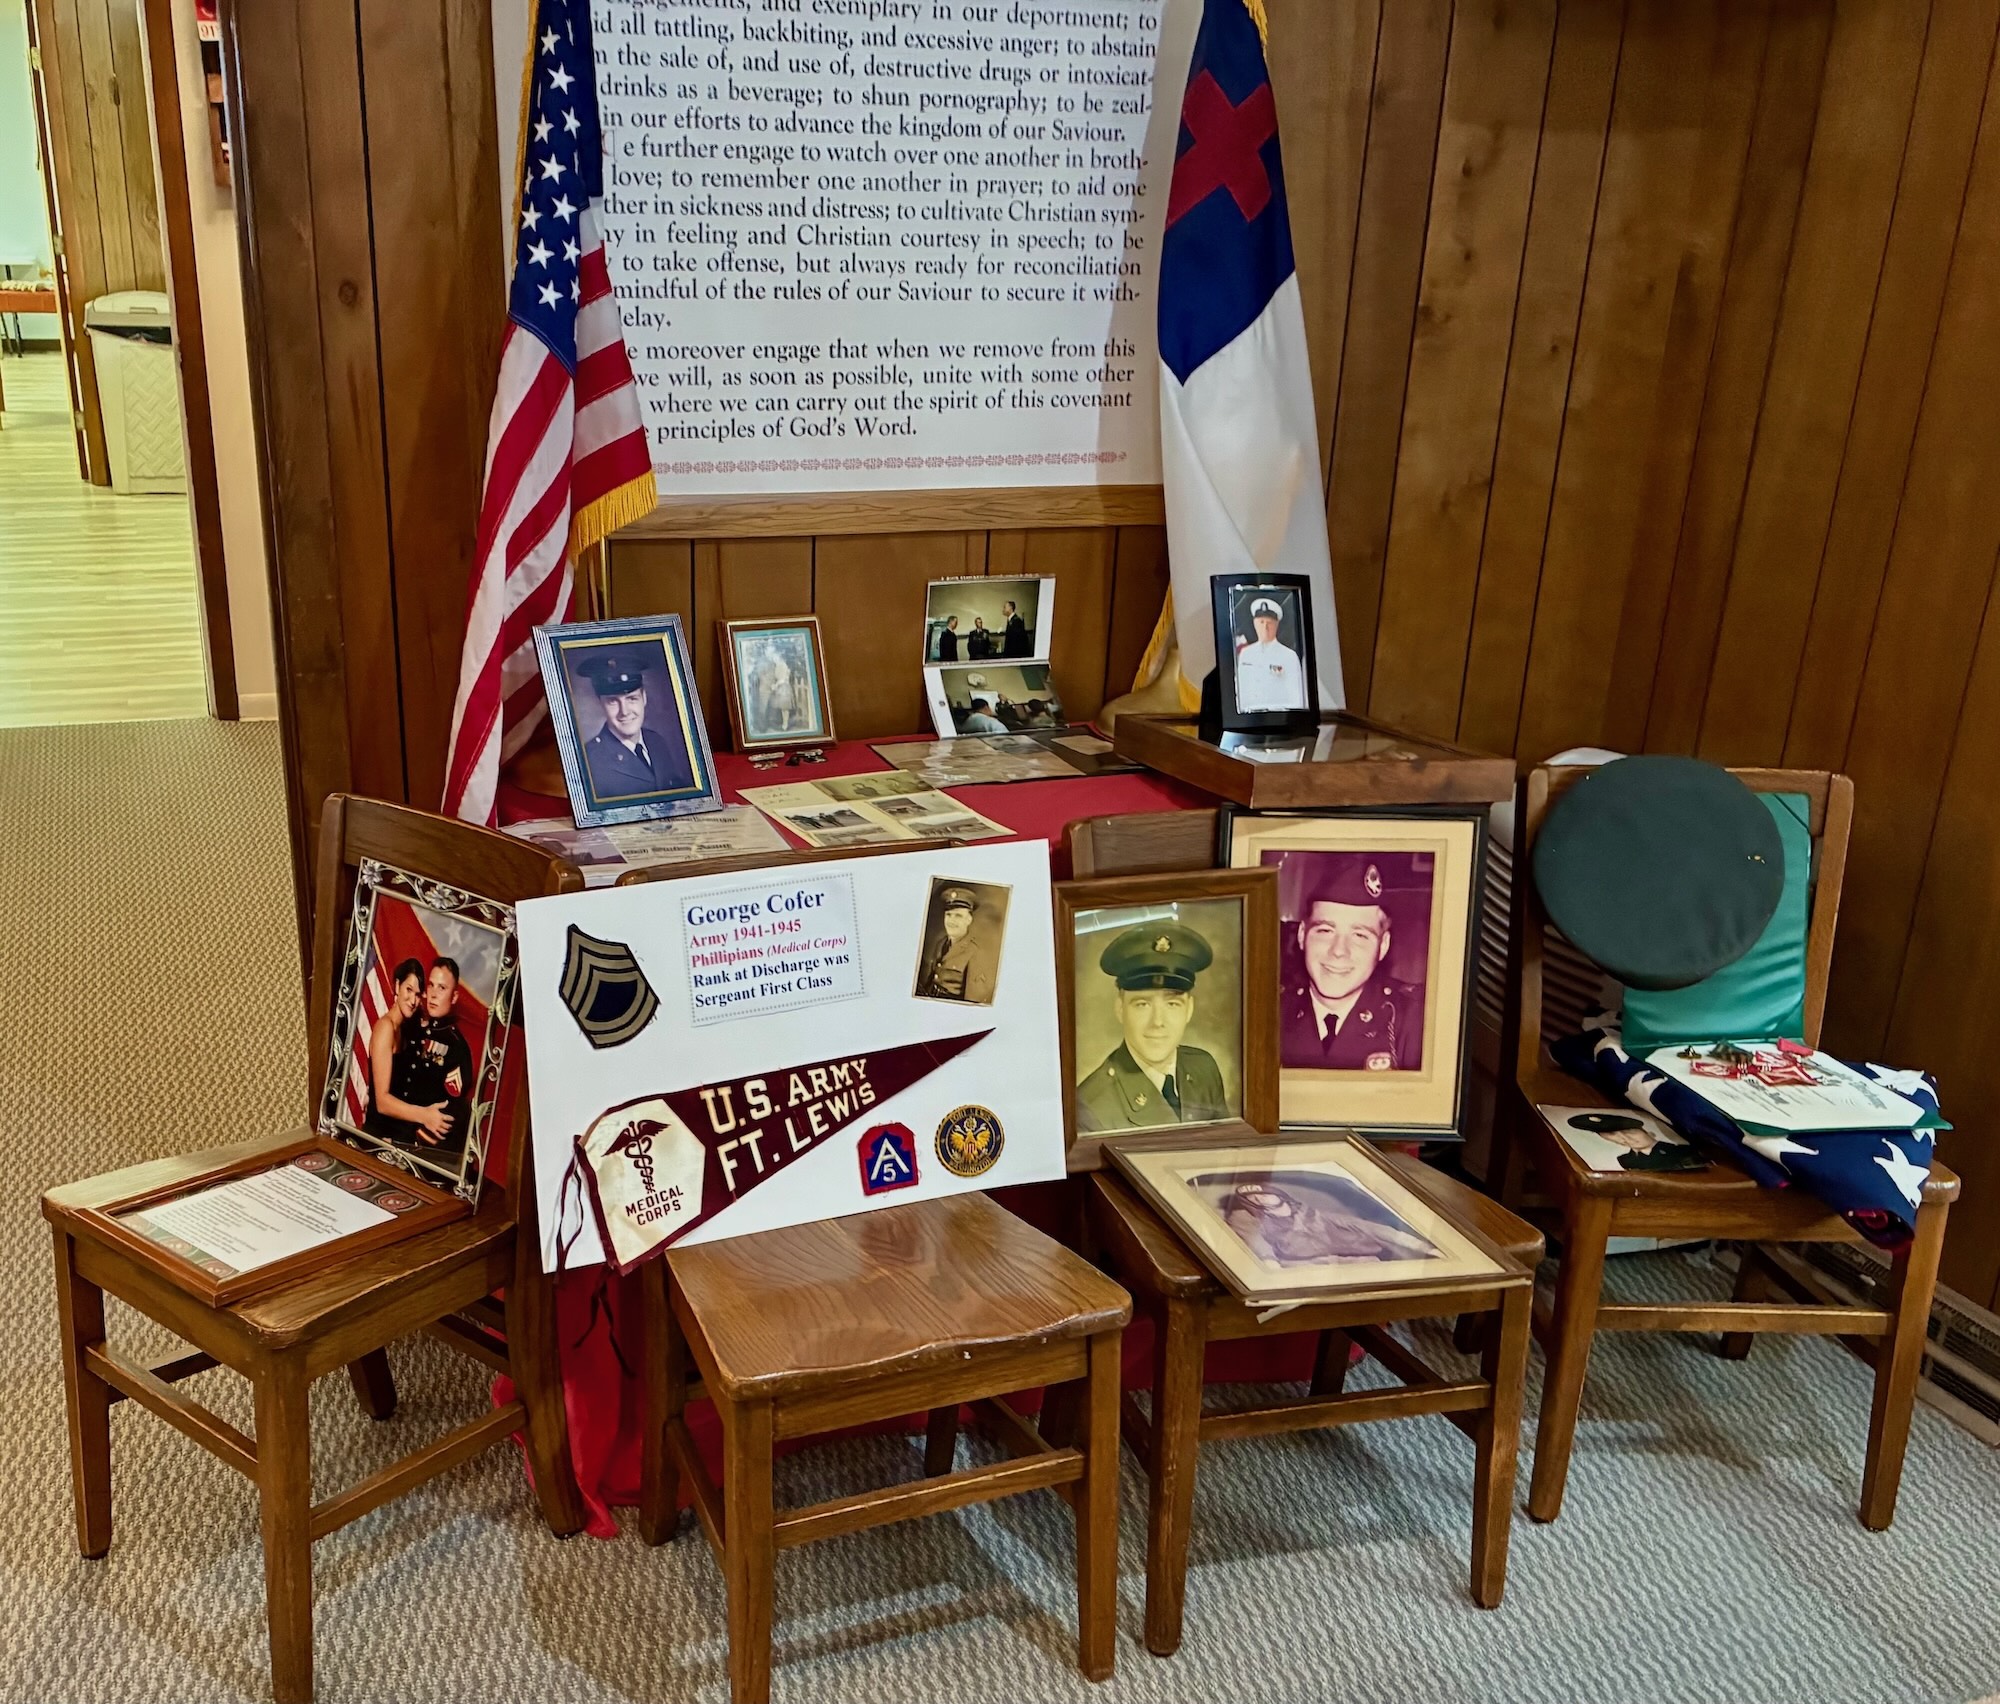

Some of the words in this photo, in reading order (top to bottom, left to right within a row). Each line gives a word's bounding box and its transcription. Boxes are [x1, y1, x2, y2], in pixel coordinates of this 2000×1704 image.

[962, 6, 998, 22] our
[1007, 1, 1128, 33] deportment;
[1139, 13, 1157, 31] to
[621, 12, 645, 36] all
[654, 15, 734, 44] tattling,
[744, 17, 853, 49] backbiting,
[861, 23, 896, 46] and
[904, 29, 993, 51] excessive
[1000, 37, 1058, 58] anger;
[1067, 38, 1085, 55] to
[1092, 33, 1155, 58] abstain
[618, 44, 651, 67] the
[660, 46, 699, 69] sale
[707, 48, 733, 74] of,
[743, 50, 779, 72] and
[789, 58, 821, 74] use
[830, 53, 854, 79] of,
[864, 54, 971, 80] destructive
[979, 58, 1031, 87] drugs
[1040, 68, 1060, 83] or
[1068, 62, 1154, 86] intoxicat-
[601, 74, 667, 98] drinks
[677, 84, 698, 99] as
[707, 84, 718, 100] a
[729, 78, 822, 109] beverage;
[833, 86, 852, 105] to
[862, 83, 910, 107] shun
[920, 88, 1046, 116] pornography;
[1057, 95, 1075, 113] to
[1083, 90, 1103, 113] be
[1112, 93, 1152, 114] zeal-
[603, 105, 623, 127] in
[631, 112, 667, 128] our
[674, 108, 740, 131] efforts
[748, 114, 768, 132] to
[774, 111, 854, 136] advance
[862, 114, 892, 135] the
[900, 114, 982, 142] kingdom
[989, 117, 1007, 139] of
[1013, 125, 1046, 140] our
[1052, 118, 1125, 142] Saviour.
[641, 136, 718, 159] further
[723, 144, 794, 168] engage
[801, 144, 821, 162] to
[827, 142, 887, 163] watch
[894, 149, 938, 164] over
[944, 150, 979, 166] one
[985, 146, 1060, 168] another
[1066, 147, 1083, 168] in
[1091, 147, 1148, 170] broth-
[612, 165, 662, 190] love;
[672, 168, 693, 188] to
[701, 168, 810, 190] remember
[818, 175, 855, 191] one
[863, 171, 941, 192] another
[950, 172, 968, 193] in
[977, 179, 1042, 201] prayer;
[1052, 179, 1070, 195] to
[1077, 174, 1105, 196] aid
[1113, 182, 1146, 197] one
[654, 194, 675, 215] in
[680, 194, 763, 217] sickness
[768, 196, 806, 218] and
[812, 197, 889, 223] distress;
[897, 203, 916, 220] to
[921, 198, 1003, 222] cultivate
[1008, 200, 1095, 223] Christian
[1101, 208, 1144, 228] sym-
[636, 223, 656, 244] in
[668, 224, 737, 253] feeling
[748, 226, 786, 245] and
[797, 226, 892, 247] Christian
[901, 231, 980, 256] courtesy
[991, 228, 1009, 248] in
[1018, 228, 1085, 256] speech;
[1096, 233, 1113, 250] to
[1124, 229, 1143, 250] be
[623, 254, 644, 271] to
[653, 251, 697, 272] take
[707, 252, 784, 275] offense,
[797, 252, 830, 273] but
[840, 253, 905, 281] always
[915, 253, 967, 280] ready
[977, 254, 1005, 275] for
[1014, 254, 1141, 276] reconciliation
[614, 278, 698, 301] mindful
[706, 278, 727, 299] of
[733, 278, 766, 300] the
[773, 279, 821, 300] rules
[828, 279, 849, 300] of
[857, 286, 891, 301] our
[898, 279, 972, 301] Saviour
[982, 285, 999, 301] to
[1007, 287, 1065, 301] secure
[1073, 281, 1086, 301] it
[1093, 280, 1139, 301] with-
[646, 345, 745, 360] moreover
[753, 345, 820, 364] engage
[829, 337, 868, 359] that
[877, 338, 929, 359] when
[939, 345, 965, 358] we
[974, 344, 1043, 358] remove
[1052, 337, 1095, 358] from
[1104, 337, 1135, 359] this
[668, 364, 712, 390] will,
[723, 372, 741, 386] as
[750, 371, 797, 386] soon
[805, 371, 824, 385] as
[833, 363, 913, 391] possible,
[923, 364, 972, 384] unite
[981, 363, 1023, 383] with
[1032, 369, 1078, 383] some
[1086, 362, 1134, 384] other
[649, 392, 712, 413] where
[719, 398, 747, 412] we
[755, 397, 790, 412] can
[796, 397, 847, 418] carry
[854, 392, 886, 411] out
[894, 389, 923, 410] the
[929, 389, 978, 414] spirit
[985, 388, 1004, 409] of
[1012, 388, 1044, 408] this
[1051, 386, 1132, 408] covenant
[657, 417, 755, 443] principles
[763, 416, 783, 438] of
[790, 414, 845, 437] God's
[856, 415, 916, 437] Word.
[687, 901, 761, 926] George
[767, 890, 825, 914] Cofer
[689, 931, 729, 949] Army
[733, 919, 802, 942] 1941-1945
[692, 946, 764, 968] Phillipians
[767, 940, 811, 958] (Medical
[813, 935, 847, 950] Corps)
[694, 970, 731, 988] Rank
[735, 968, 748, 981] at
[752, 957, 820, 978] Discharge
[823, 953, 850, 966] was
[695, 986, 756, 1008] Sergeant
[760, 980, 793, 997] First
[796, 974, 833, 991] Class
[699, 1079, 781, 1135] U.S.
[788, 1059, 867, 1107] ARMY
[717, 1128, 781, 1192] FT.
[785, 1082, 876, 1153] LEWIS
[871, 1137, 910, 1180] A
[883, 1163, 897, 1182] 5
[625, 1185, 684, 1217] MEDICAL
[637, 1199, 681, 1226] CORPS
